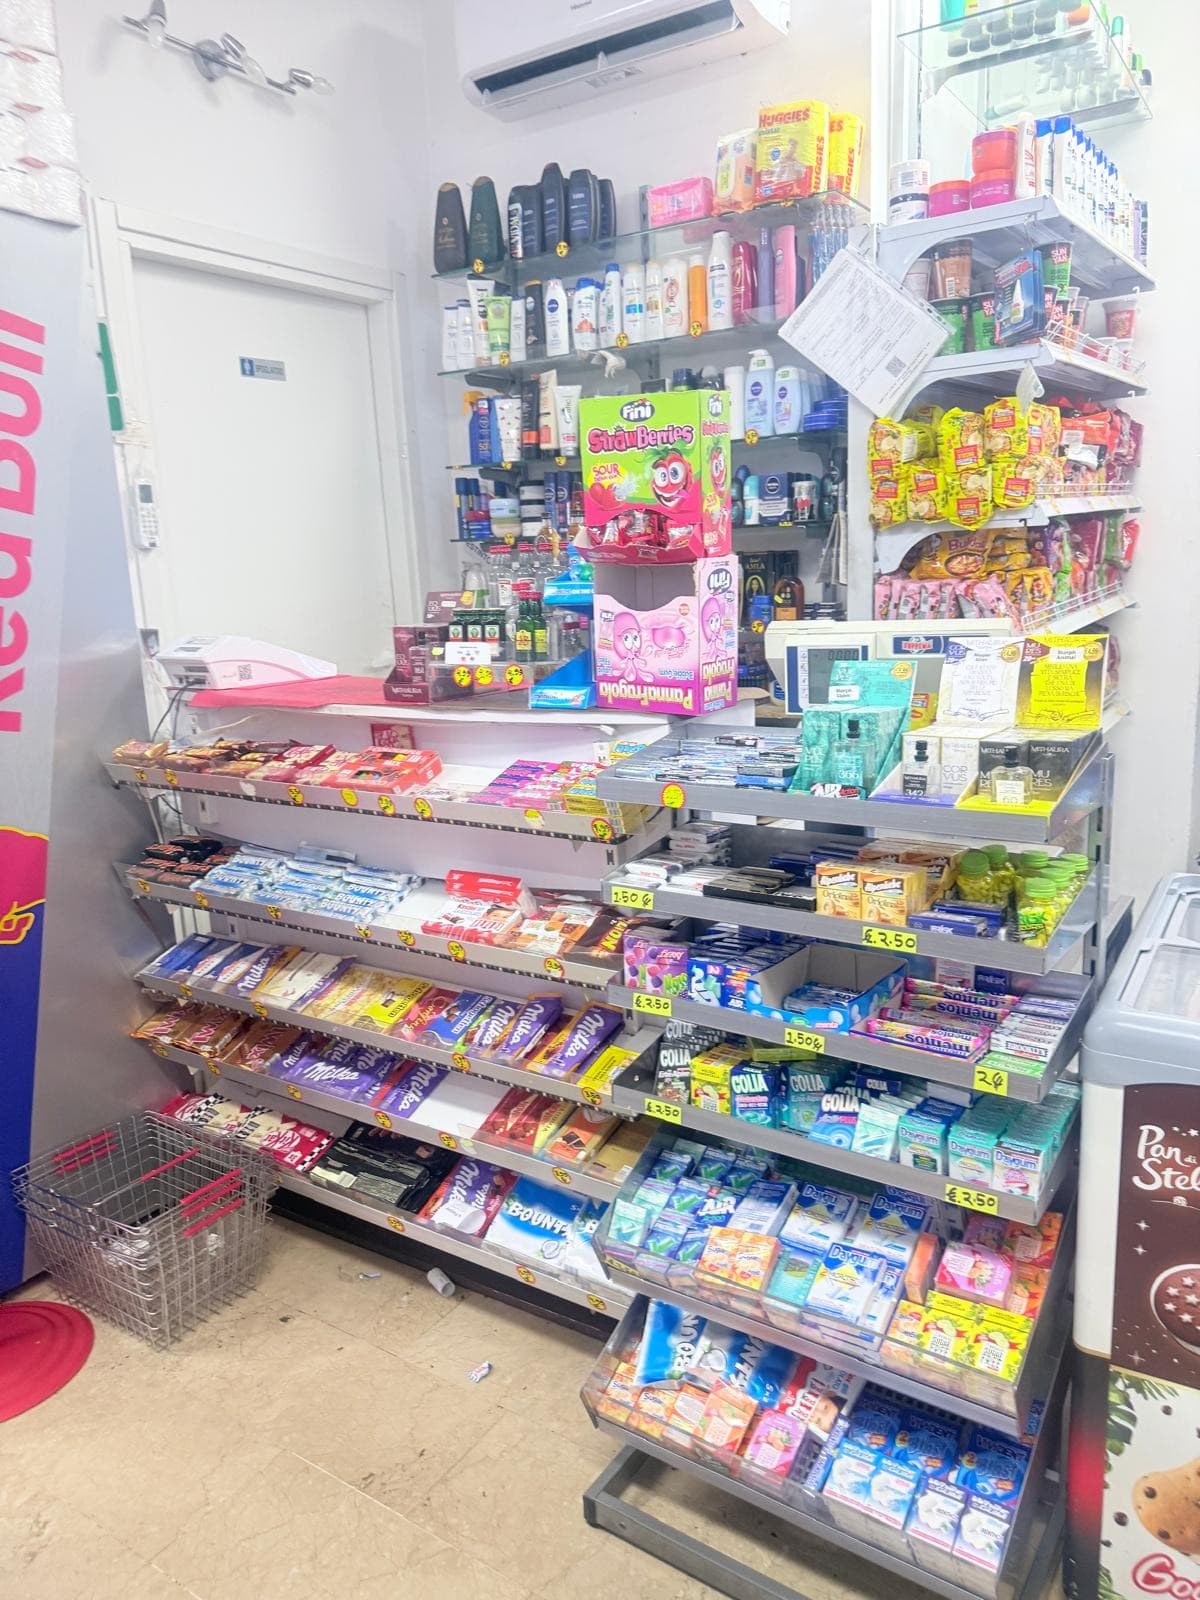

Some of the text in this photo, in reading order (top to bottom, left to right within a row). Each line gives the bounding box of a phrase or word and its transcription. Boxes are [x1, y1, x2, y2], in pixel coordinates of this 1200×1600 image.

[758, 108, 811, 128] HUGGIES
[812, 135, 825, 193] HUGGIES
[843, 147, 855, 192] UGGIES
[592, 463, 621, 477] SOUR
[235, 956, 271, 992] Milka
[935, 1002, 999, 1022] mentos
[481, 1003, 516, 1047] Milka
[508, 1002, 546, 1046] Milka
[564, 1012, 605, 1059] Milka
[903, 1033, 971, 1054] mentos
[659, 1048, 692, 1068] GOLIA
[303, 1061, 361, 1082] Milka
[398, 1063, 439, 1112] Milka
[731, 1073, 770, 1094] GOLIA
[789, 1074, 826, 1093] GOLIA
[822, 1093, 860, 1113] GOLIA
[900, 1126, 940, 1146] Daygum
[1137, 1124, 1191, 1168] Pan
[950, 1140, 991, 1160] Daygum
[995, 1150, 1038, 1171] Daygum
[701, 1197, 738, 1216] AIR
[875, 1195, 926, 1221] Daygum
